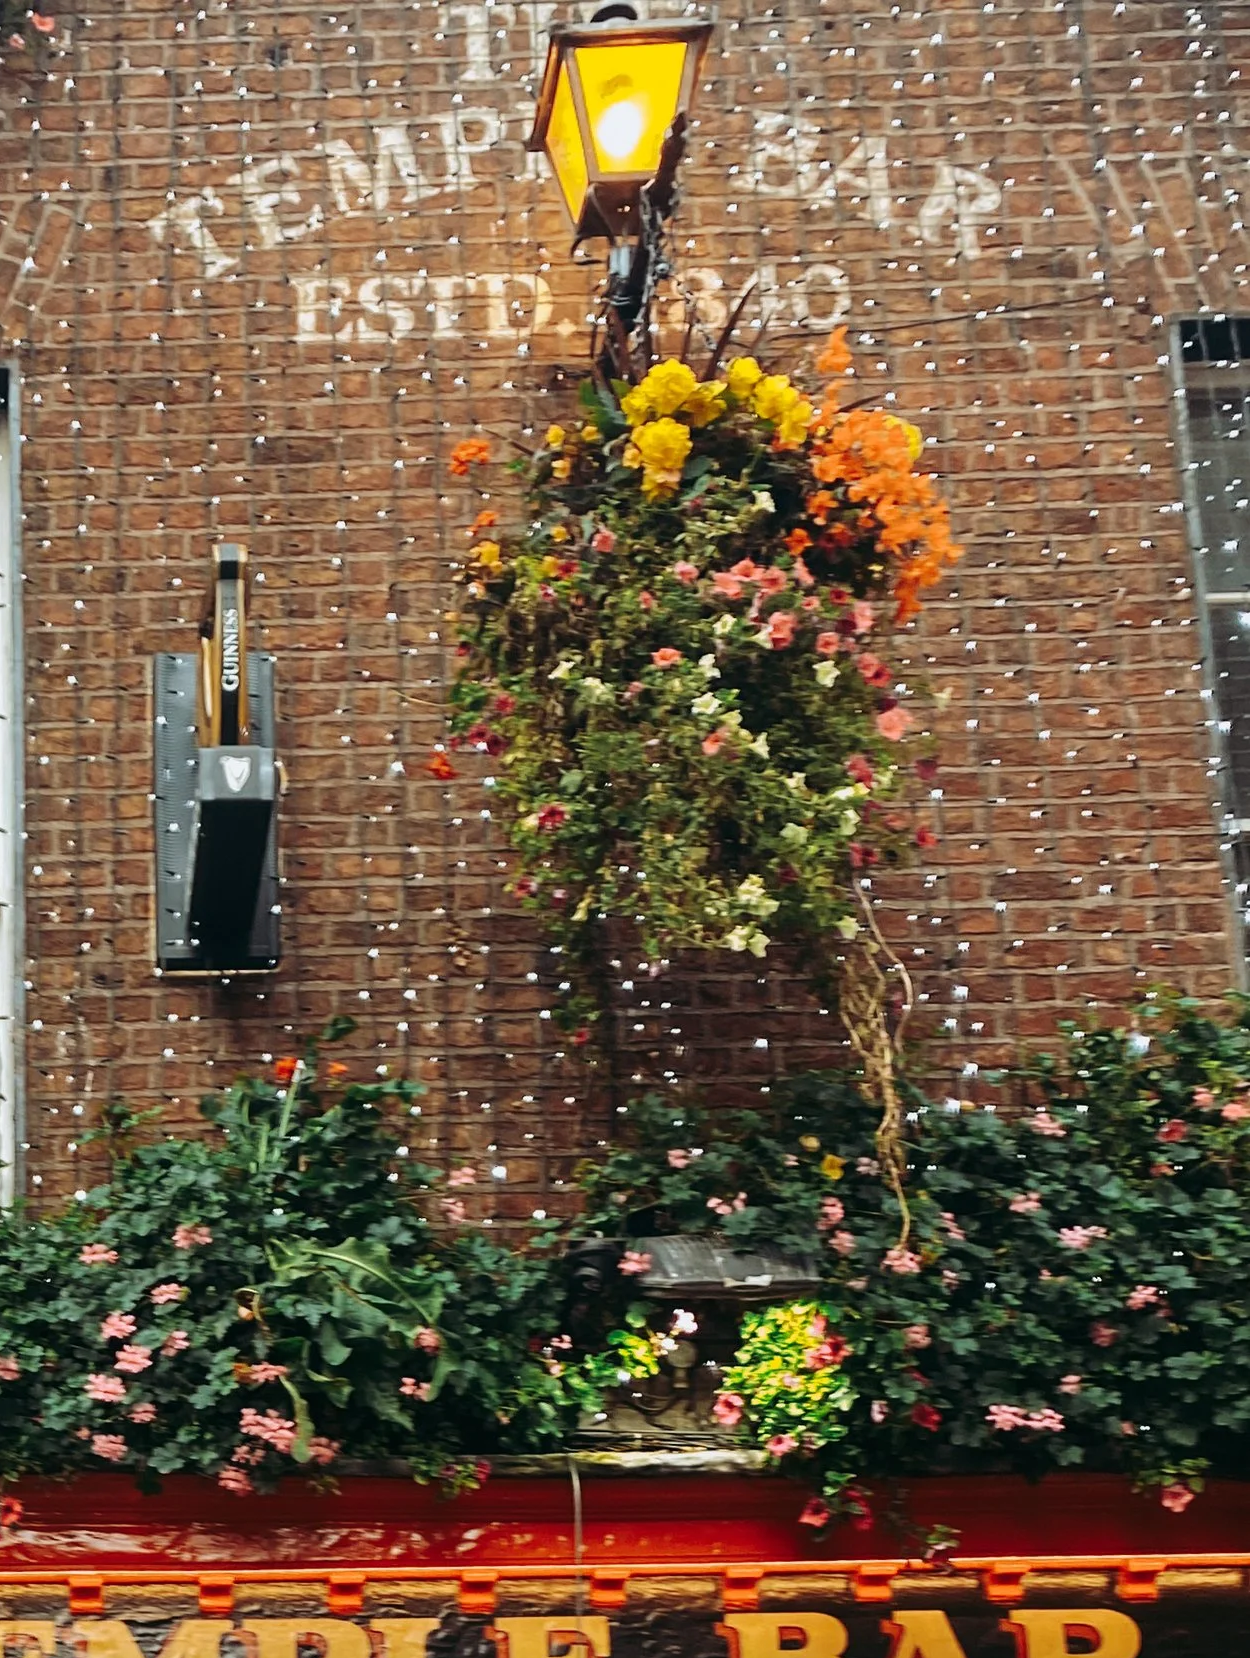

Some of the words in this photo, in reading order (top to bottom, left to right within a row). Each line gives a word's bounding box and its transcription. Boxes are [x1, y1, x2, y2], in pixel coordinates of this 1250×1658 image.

[148, 100, 553, 278] TEMP
[734, 108, 1004, 262] BAR
[221, 606, 240, 693] GUINNESS
